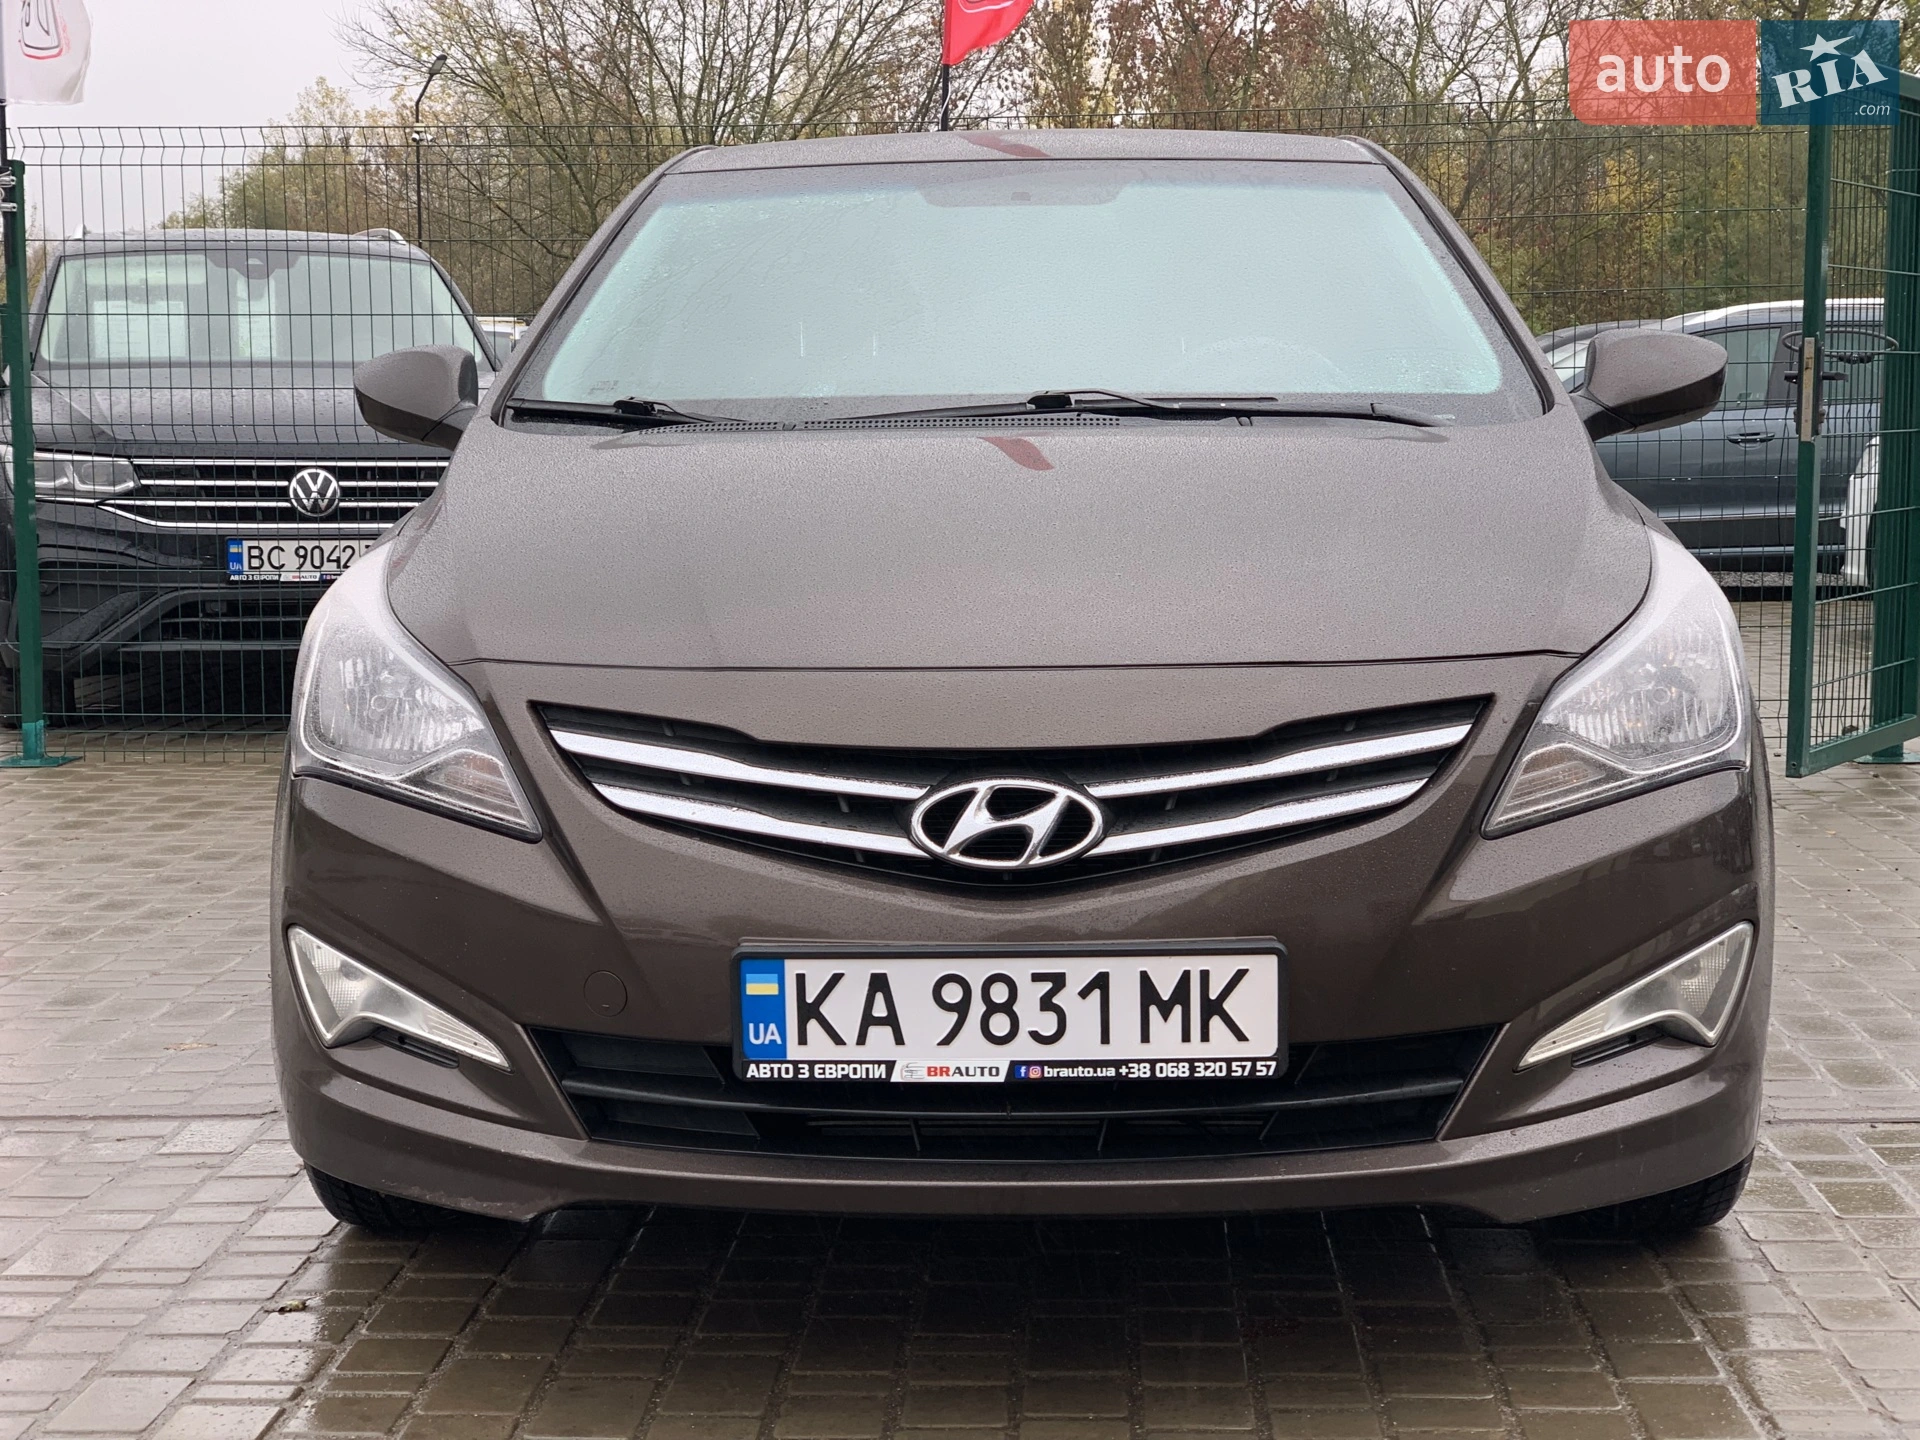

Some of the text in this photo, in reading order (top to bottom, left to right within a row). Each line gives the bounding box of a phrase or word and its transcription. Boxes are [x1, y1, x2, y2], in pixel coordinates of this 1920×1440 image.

[247, 545, 356, 570] BC 9042
[795, 967, 1250, 1047] KA 9831 MK
[748, 1022, 782, 1045] UA
[746, 1063, 794, 1080] АВТО
[813, 1063, 887, 1079] ЄВРОПИ
[926, 1065, 1000, 1078] BRAUTO
[1043, 1060, 1278, 1078] brauto.ua +38 068 320 57 57
